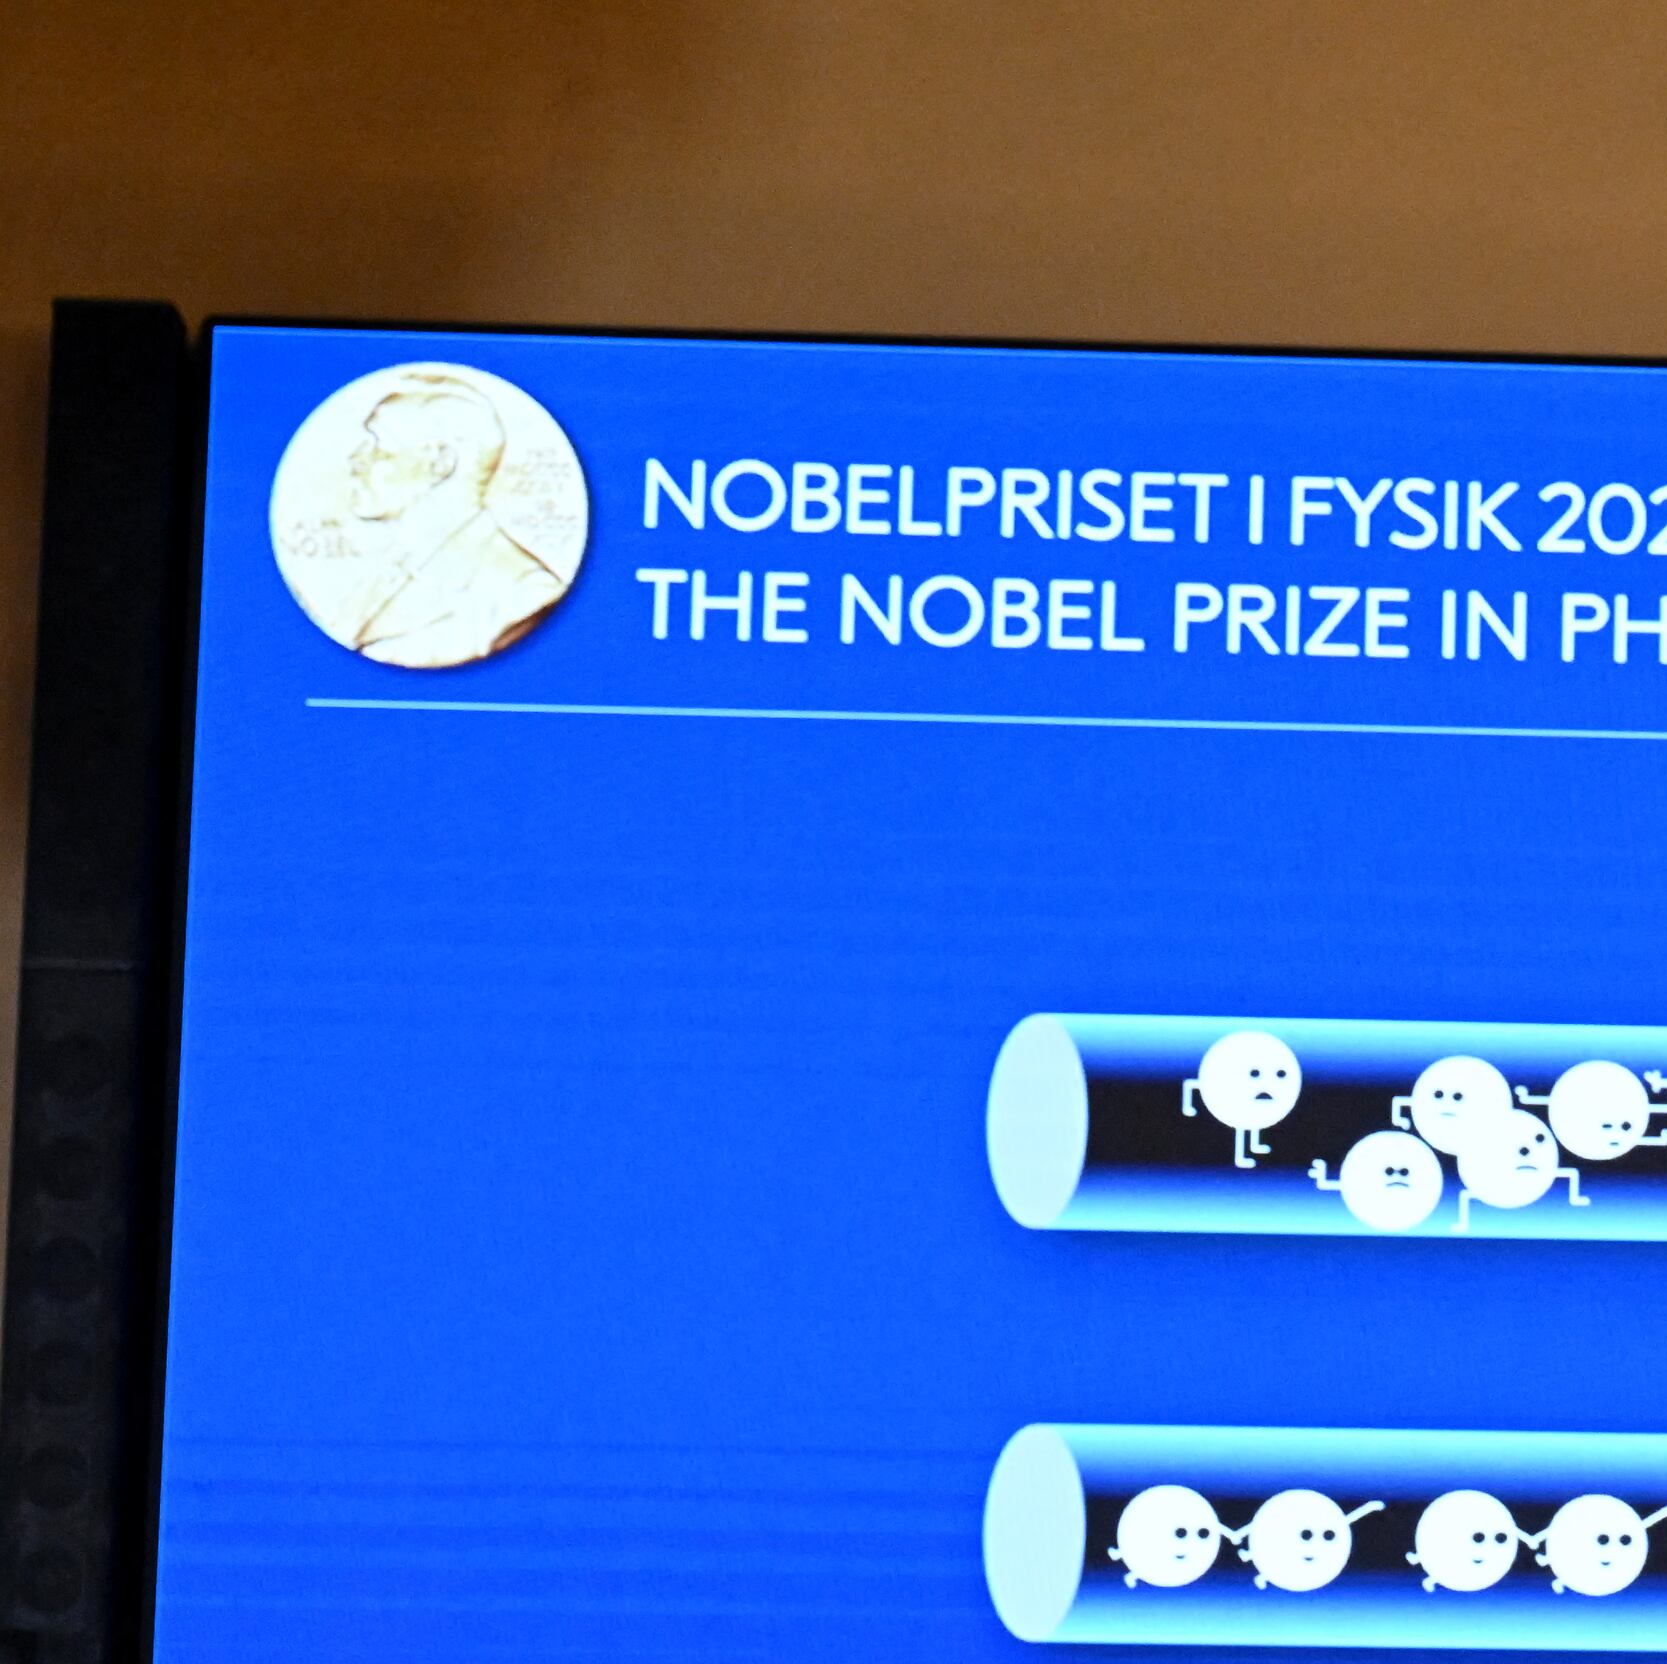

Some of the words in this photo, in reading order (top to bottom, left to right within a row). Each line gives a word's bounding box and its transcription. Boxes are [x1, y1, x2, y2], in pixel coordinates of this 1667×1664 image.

[642, 457, 1230, 545] NOBELPRISET
[1247, 473, 1266, 546] I
[1289, 474, 1523, 553] FYSIK
[634, 567, 811, 644] THE
[839, 572, 1147, 653] NOBEL
[1172, 581, 1411, 660] PRIZE
[1440, 588, 1529, 663] IN
